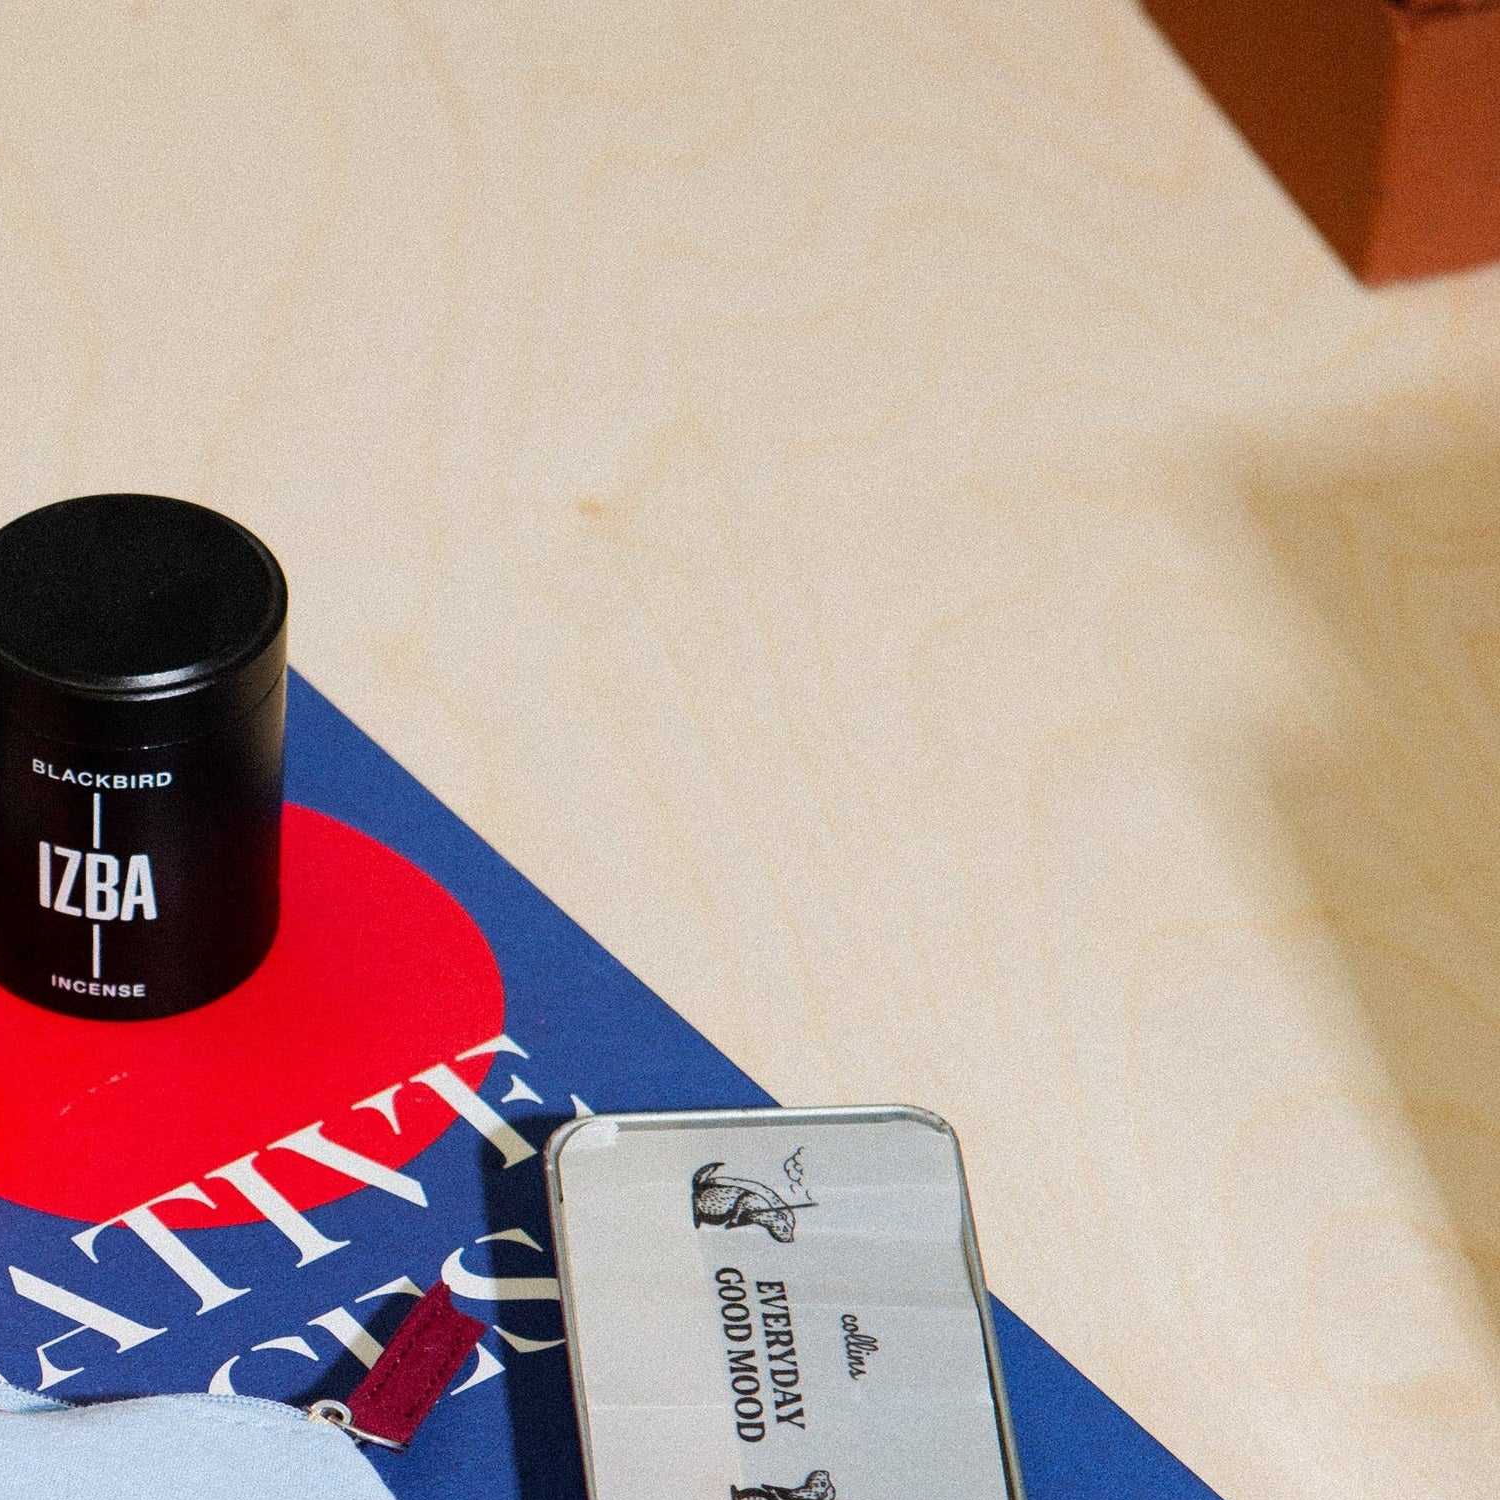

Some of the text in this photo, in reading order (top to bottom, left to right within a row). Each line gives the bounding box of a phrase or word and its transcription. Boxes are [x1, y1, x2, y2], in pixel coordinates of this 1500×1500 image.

[32, 758, 173, 790] BLACKBIRD
[39, 840, 158, 922] IZBA
[51, 973, 146, 998] INCENSE
[714, 1266, 766, 1443] GOOD MOOD
[755, 1280, 806, 1430] EVERYDAY
[840, 1313, 879, 1381] collins
